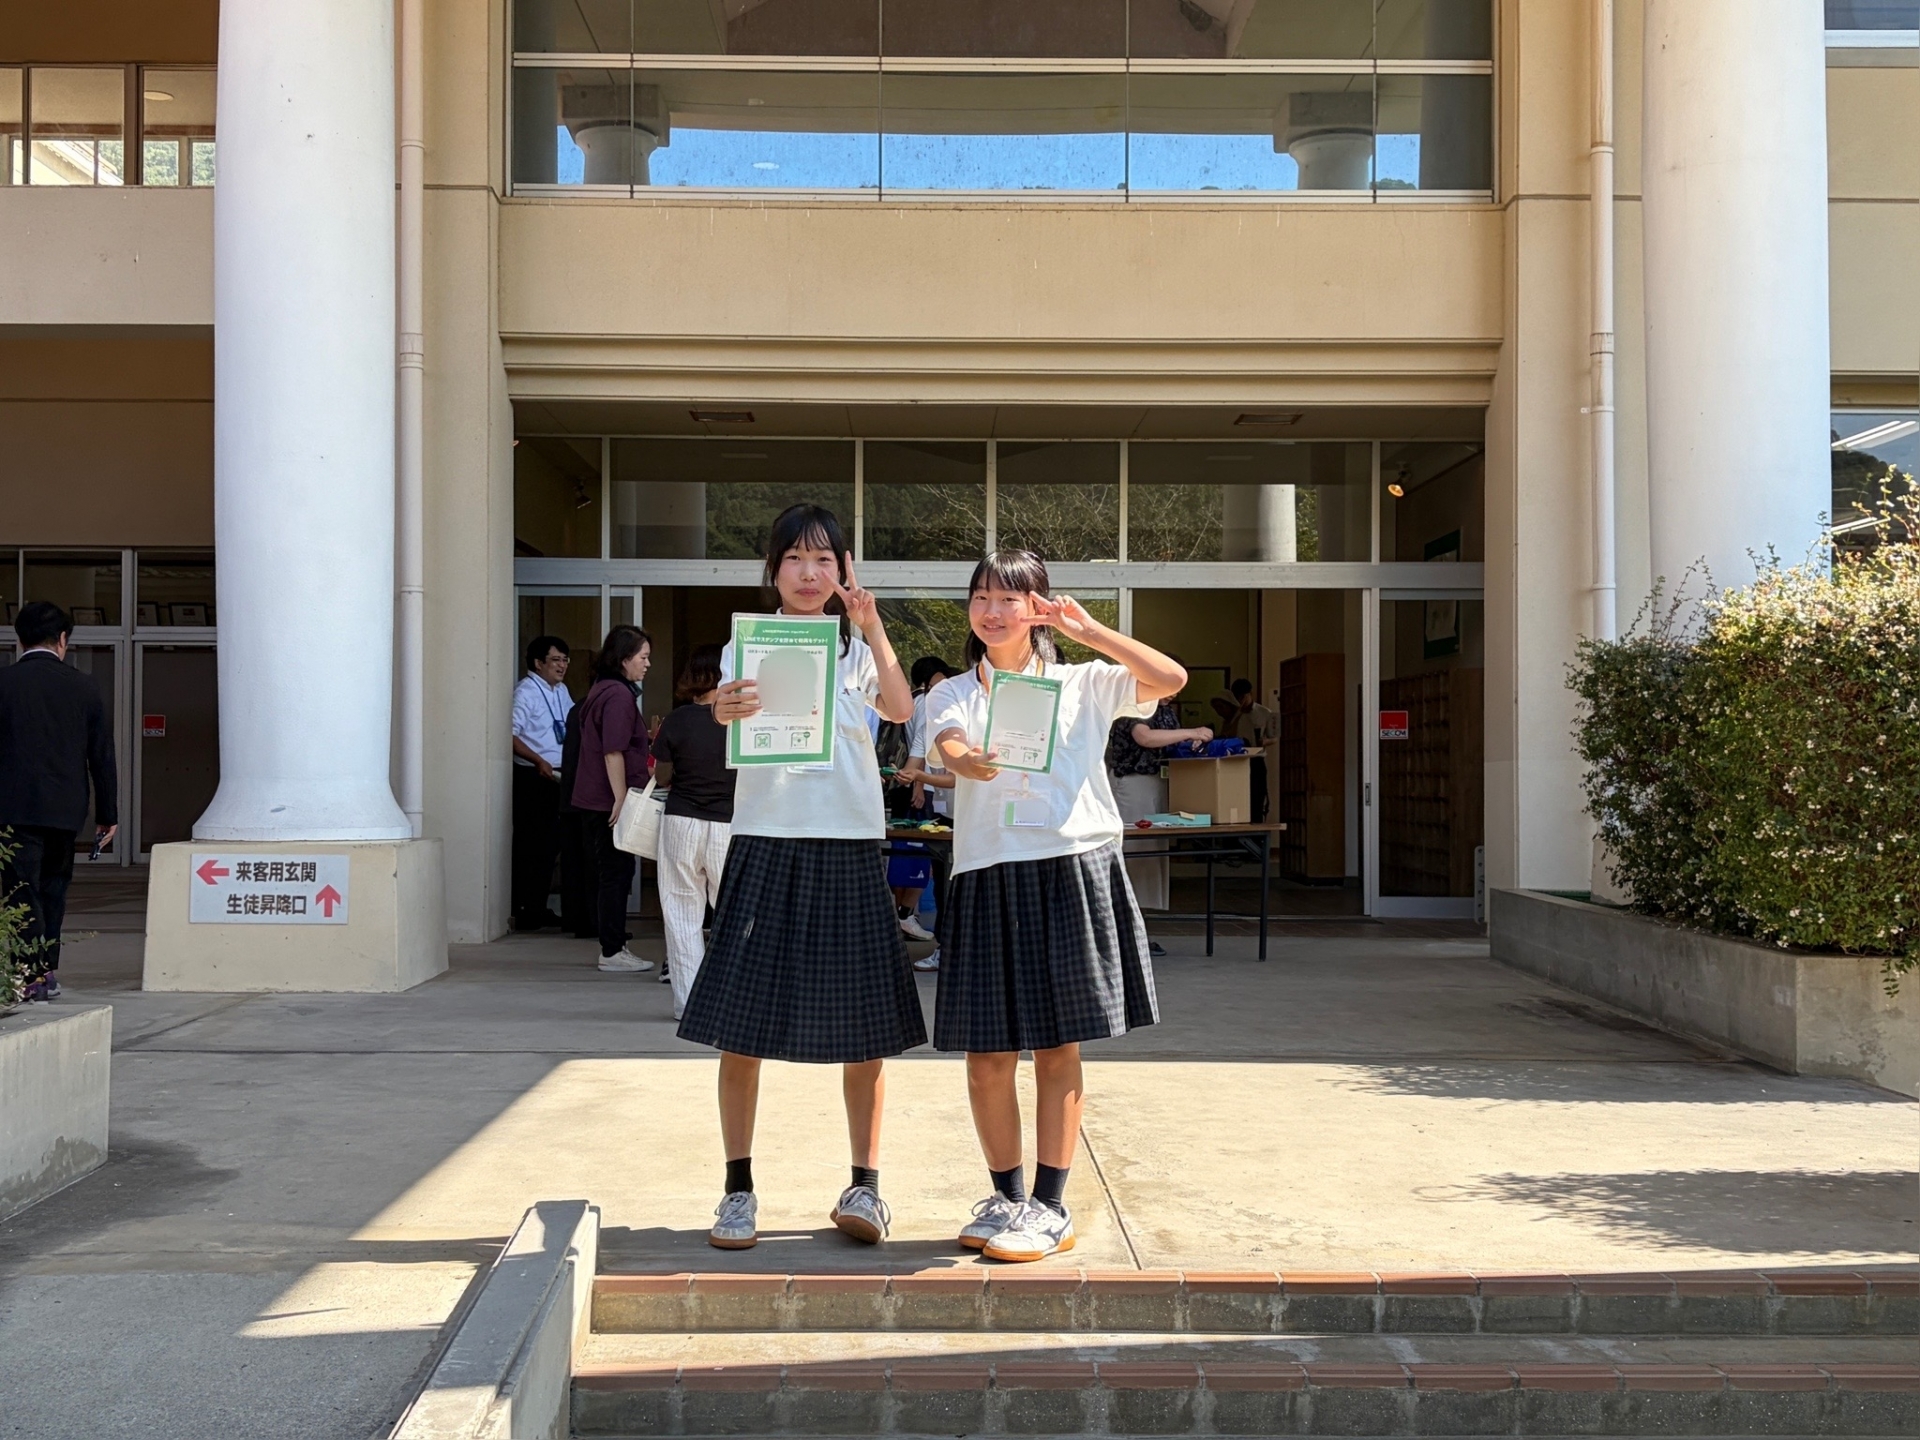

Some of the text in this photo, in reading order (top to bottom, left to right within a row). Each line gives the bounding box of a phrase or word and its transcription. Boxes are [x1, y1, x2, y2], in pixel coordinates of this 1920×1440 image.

[236, 861, 317, 883] 来客用玄関
[226, 893, 307, 916] 生徒昇降口
